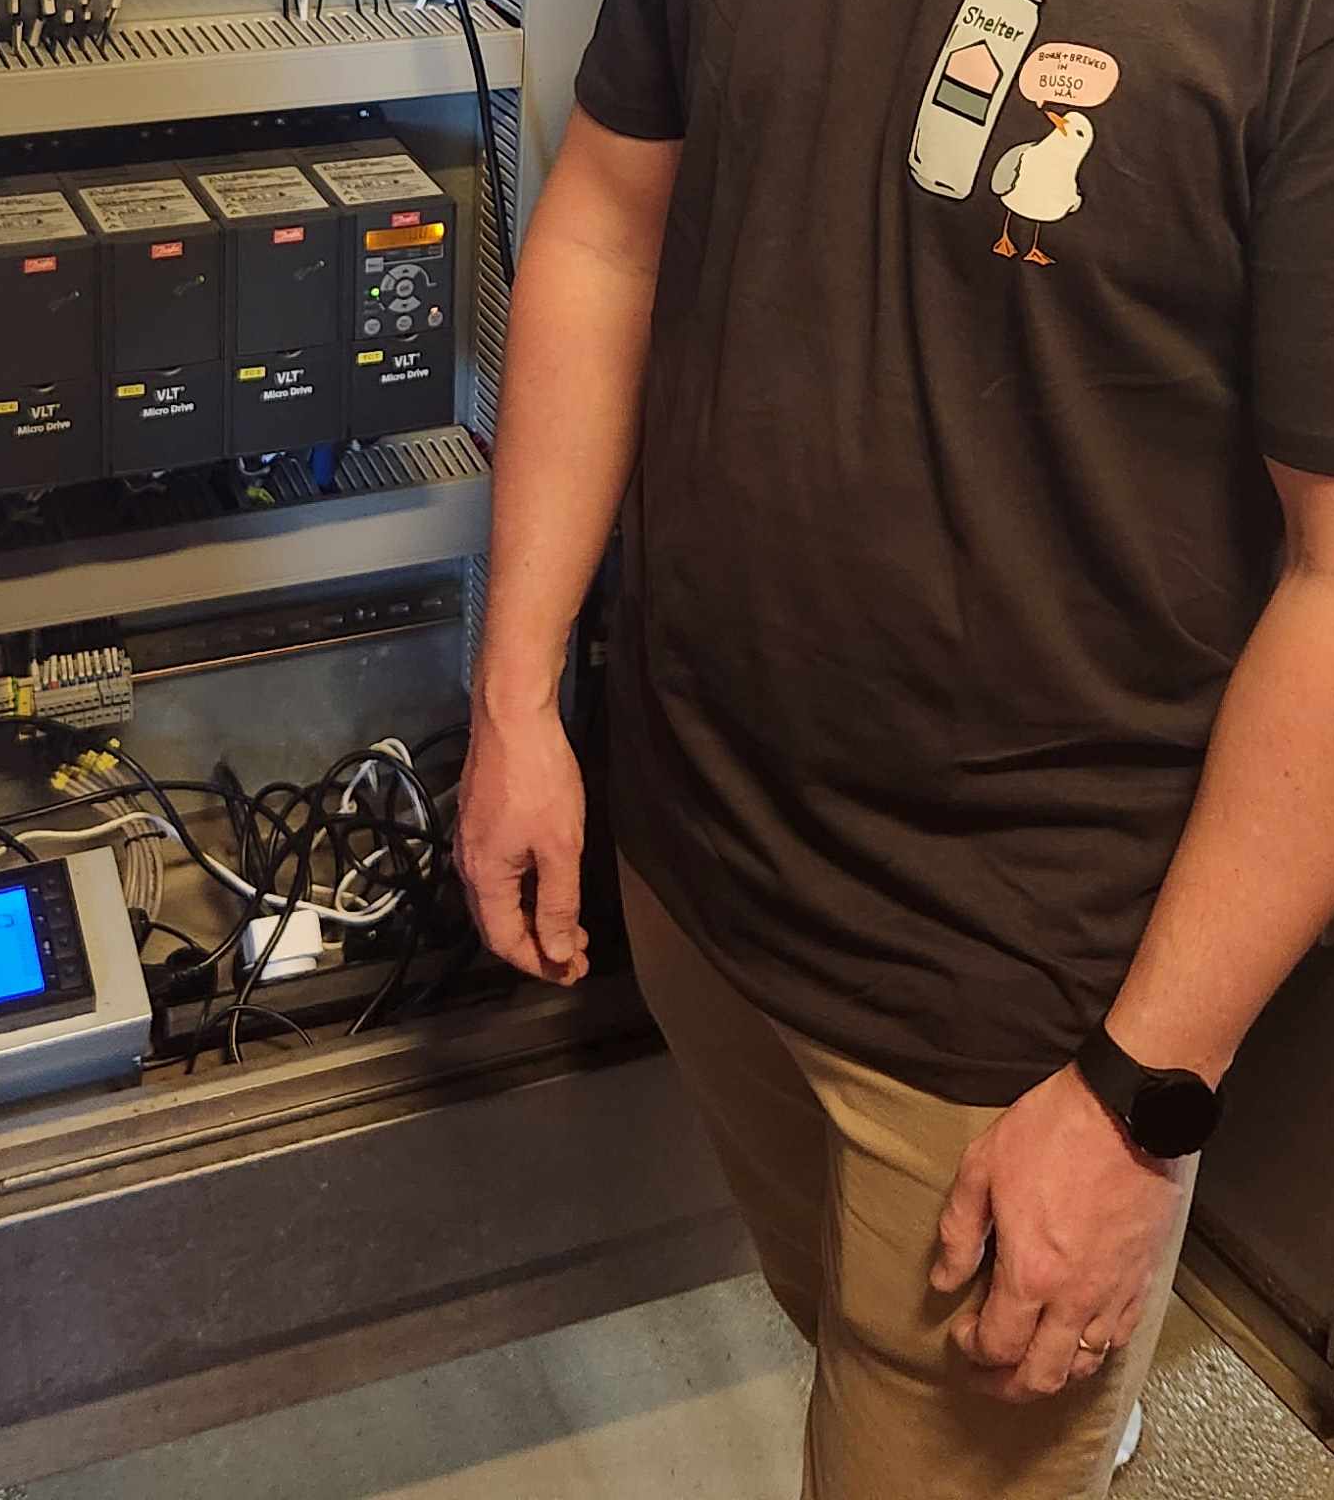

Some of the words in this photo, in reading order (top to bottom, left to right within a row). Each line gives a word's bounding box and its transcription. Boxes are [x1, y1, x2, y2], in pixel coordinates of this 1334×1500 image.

[963, 6, 1024, 42] Shelter
[1039, 74, 1084, 90] BUSSO
[381, 373, 406, 384] Micro
[407, 368, 429, 379] Drive
[262, 390, 289, 401] Micro
[290, 385, 313, 397] Drive
[142, 406, 170, 418] Micro
[170, 402, 195, 413] Drive
[17, 424, 44, 436] Micro
[46, 420, 71, 431] Drive
